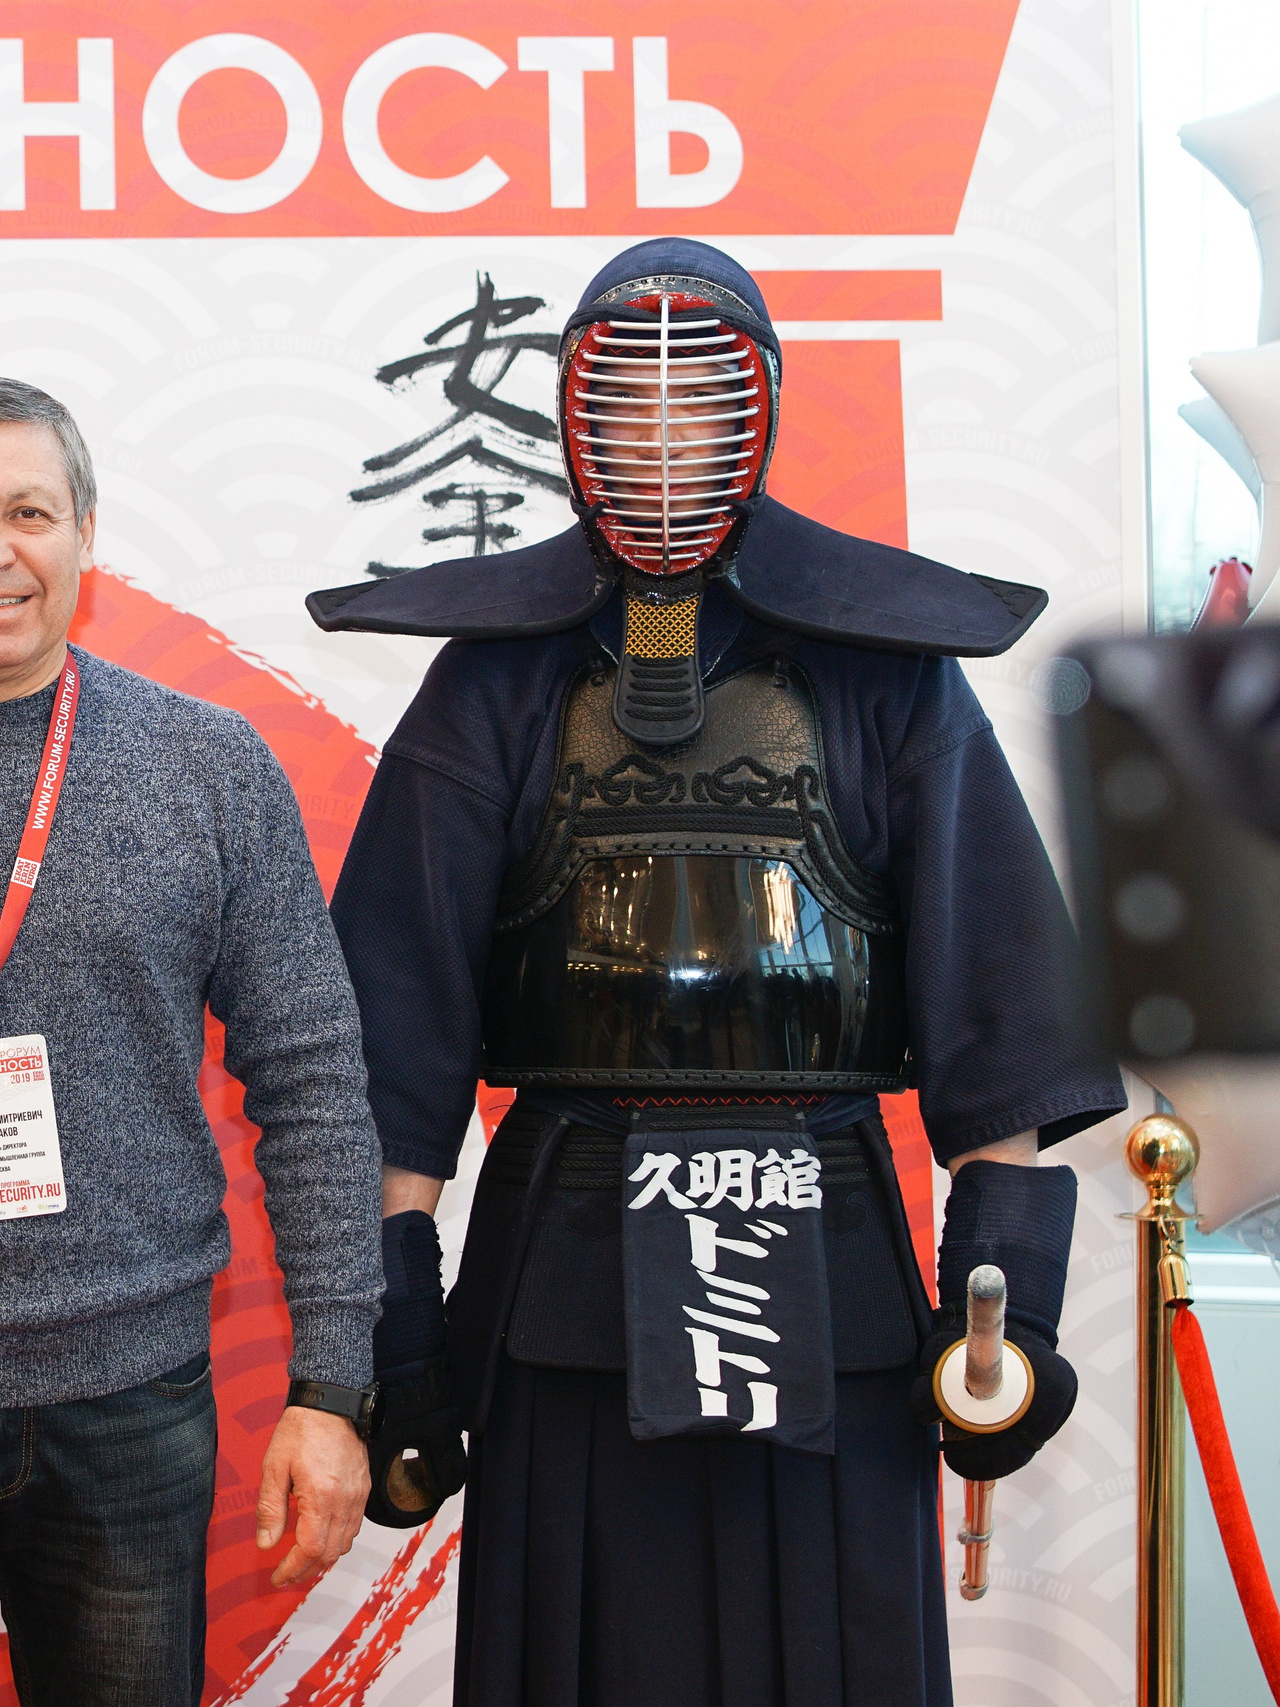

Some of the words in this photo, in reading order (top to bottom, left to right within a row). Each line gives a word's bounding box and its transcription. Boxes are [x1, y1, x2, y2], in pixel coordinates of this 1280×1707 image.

[32, 669, 76, 830] WWW.FORUM-SECURITY.RU
[10, 1072, 31, 1085] 2019
[2, 1141, 28, 1151] ДИРЕКТОРА
[29, 1150, 46, 1159] ГРУППА
[0, 1179, 30, 1190] ПРОГРАММА
[627, 1148, 823, 1212] 久明館
[681, 1213, 789, 1432] ドミトリ
